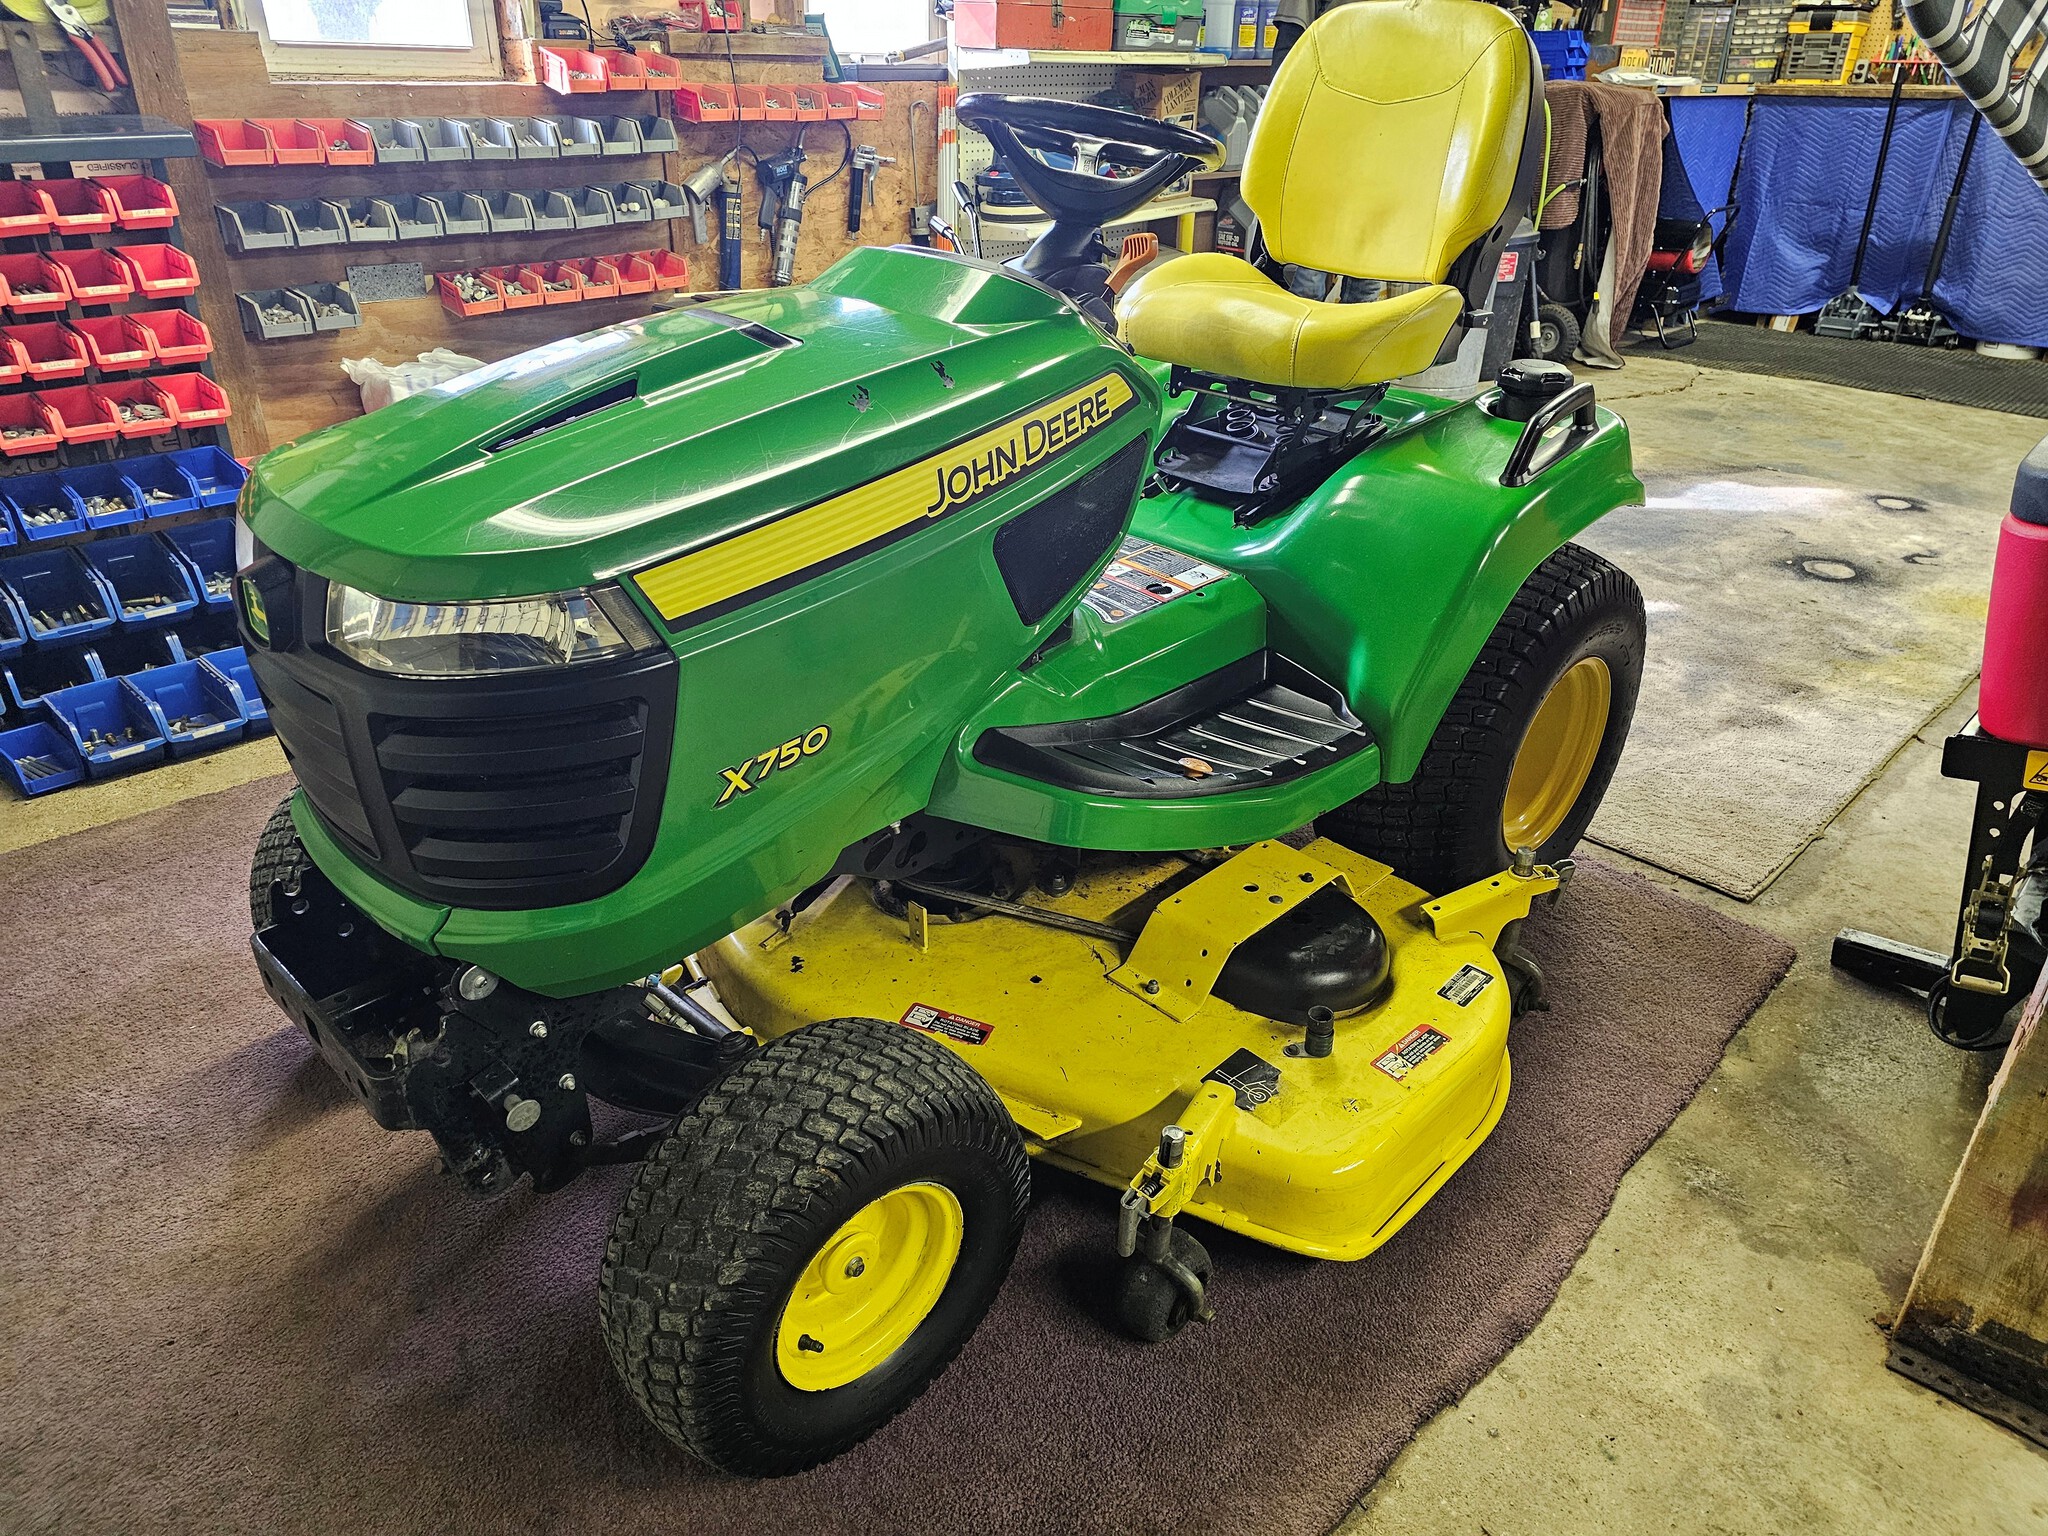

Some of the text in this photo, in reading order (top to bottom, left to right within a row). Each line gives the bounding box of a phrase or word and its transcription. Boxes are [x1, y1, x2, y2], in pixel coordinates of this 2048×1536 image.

[1649, 56, 1675, 76] HOME
[1163, 76, 1192, 105] COLEMAN
[1165, 85, 1193, 114] LANTERN
[86, 162, 139, 172] CLASSIFIED
[927, 386, 1112, 516] JOHN DEERE
[714, 725, 831, 806] X750
[955, 1016, 981, 1028] DANGER
